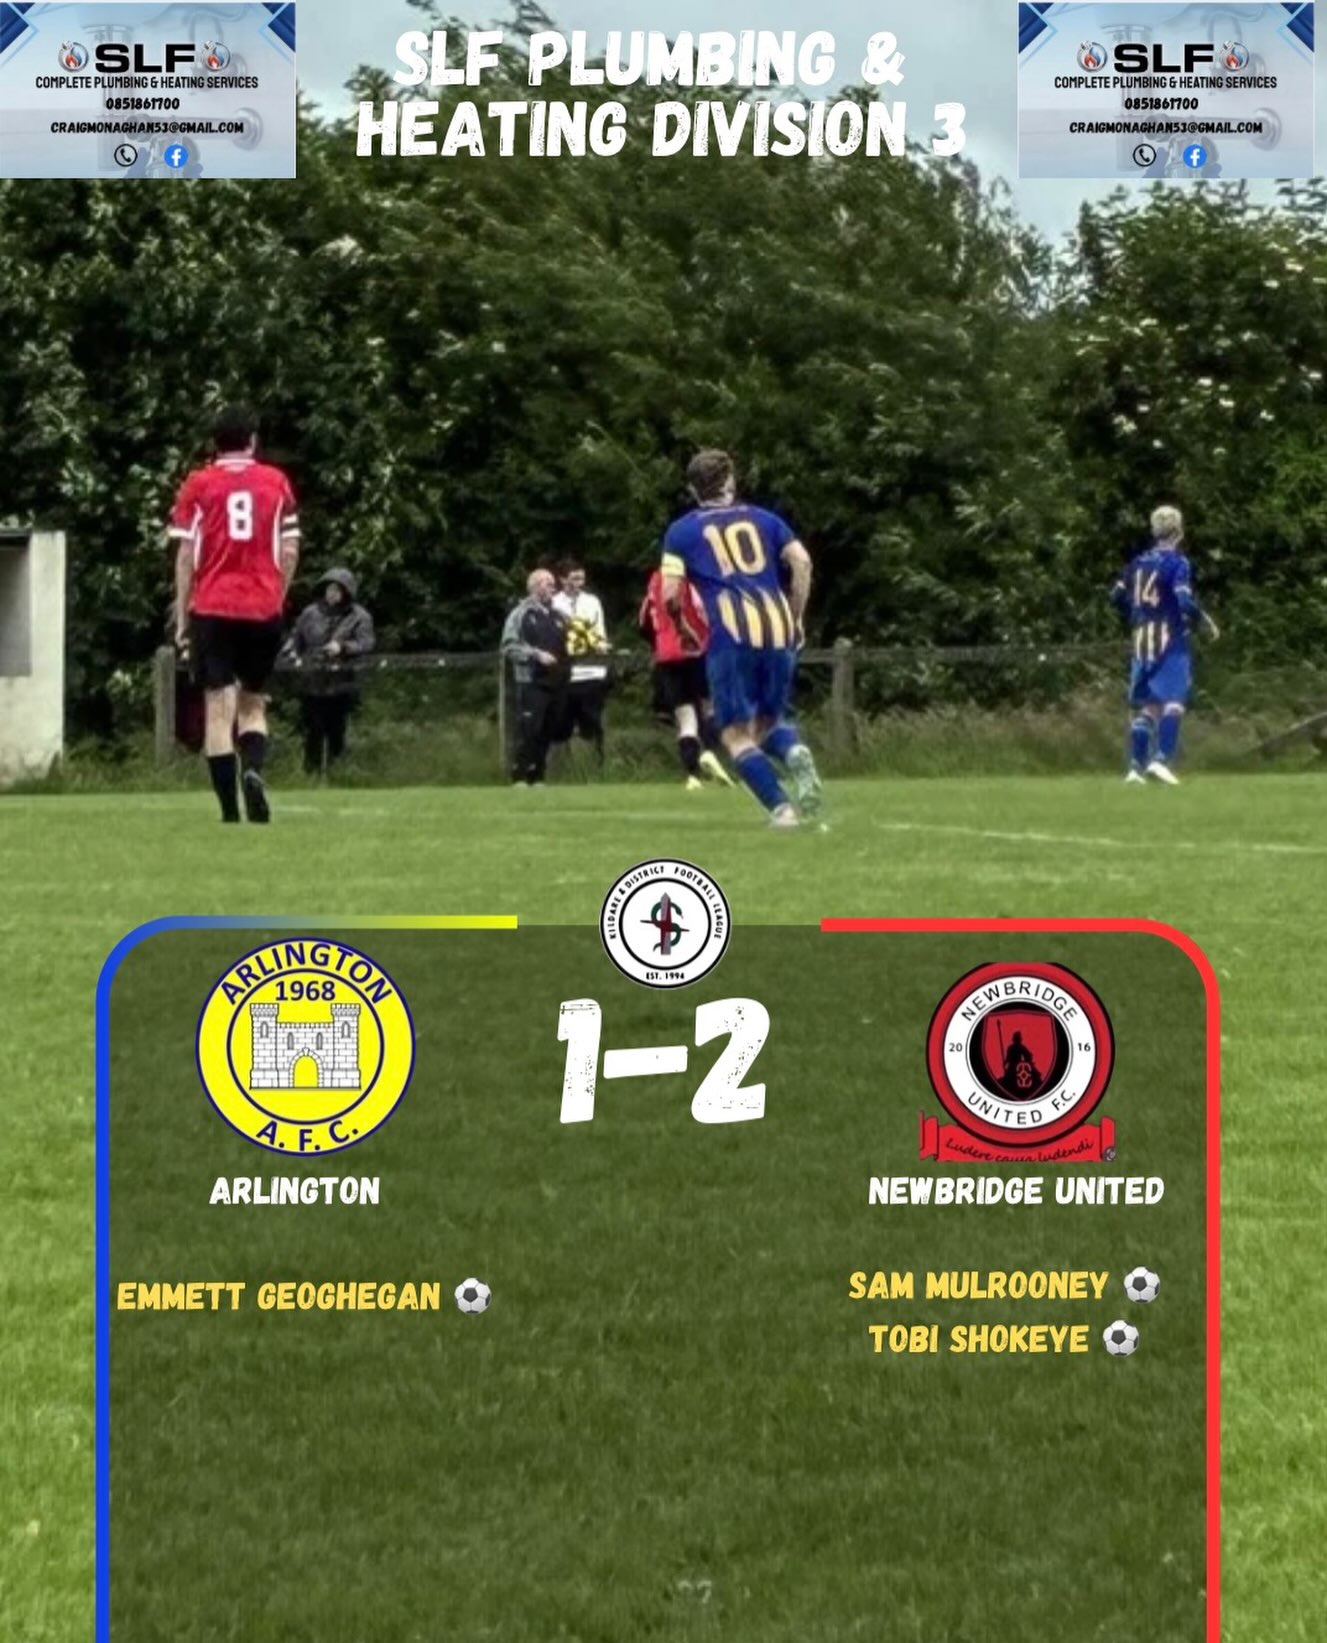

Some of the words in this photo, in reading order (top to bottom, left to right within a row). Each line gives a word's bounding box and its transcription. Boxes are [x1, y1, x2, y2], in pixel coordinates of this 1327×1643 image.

[226, 490, 254, 540] 8
[703, 521, 766, 577] 10
[1133, 568, 1160, 608] 14
